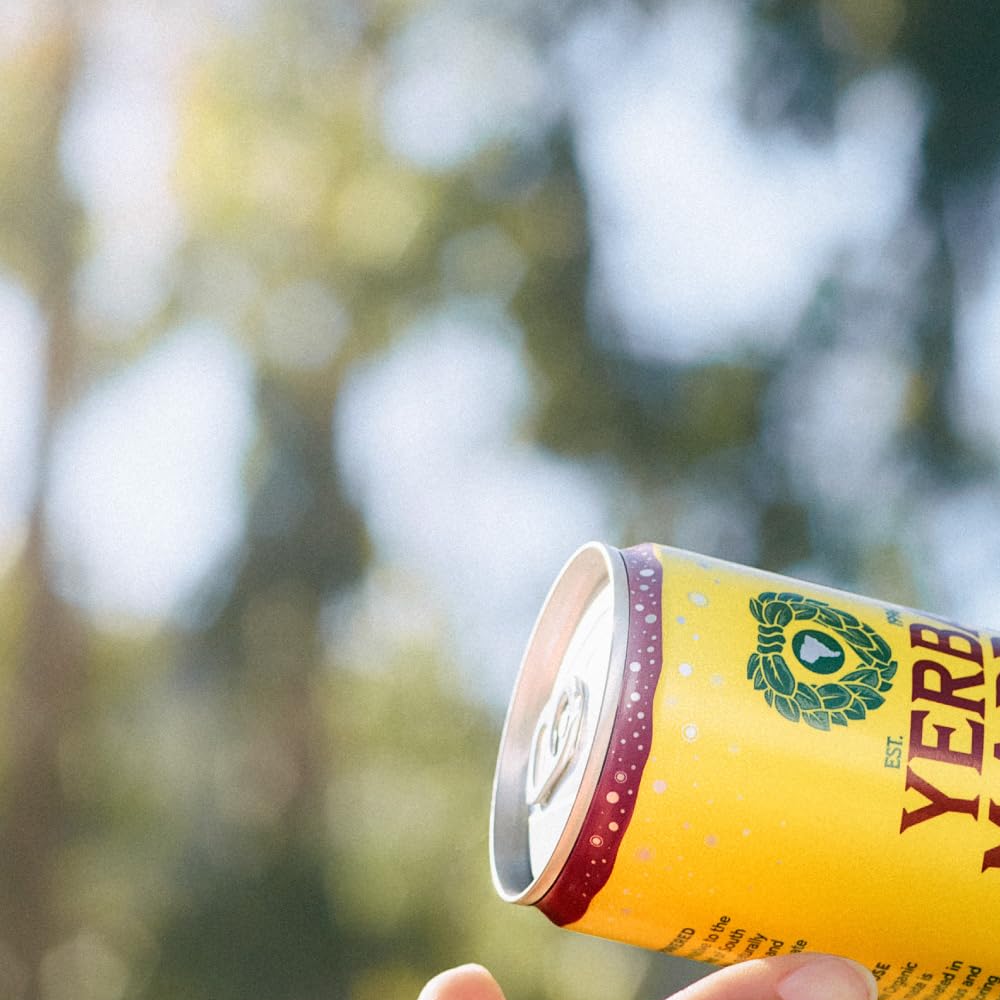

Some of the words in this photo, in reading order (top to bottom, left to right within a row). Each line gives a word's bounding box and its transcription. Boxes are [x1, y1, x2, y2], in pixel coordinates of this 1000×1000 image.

[899, 613, 987, 835] YERB
[884, 735, 904, 769] EST.
[711, 915, 731, 933] the
[946, 960, 963, 972] in
[963, 965, 982, 987] and
